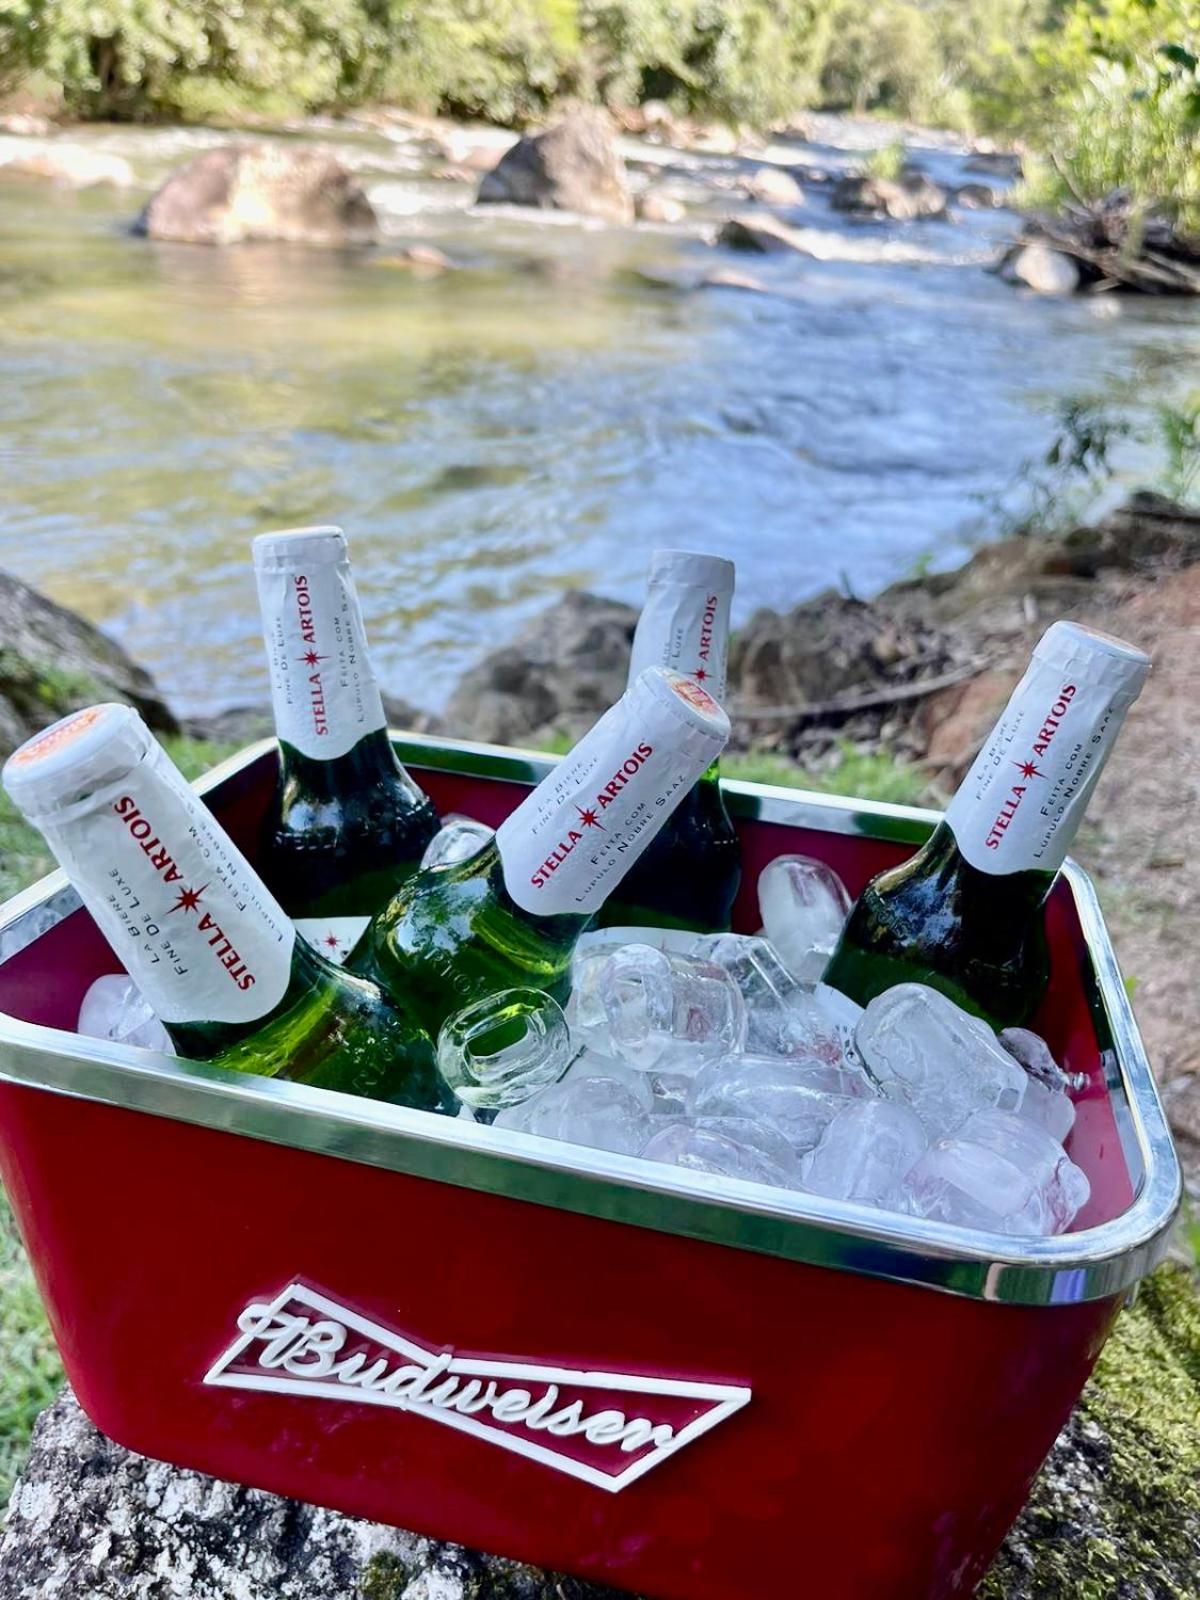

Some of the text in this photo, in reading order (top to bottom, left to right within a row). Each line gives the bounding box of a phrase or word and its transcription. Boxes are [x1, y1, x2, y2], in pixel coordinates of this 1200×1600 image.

[294, 575, 328, 736] STELLA ARTOIS
[698, 595, 718, 662] ARTOIS
[985, 683, 1076, 851] STELLA ARTOIS
[1065, 743, 1082, 770] COM
[114, 795, 184, 884] ARTOIS
[530, 742, 654, 889] STELLA ARTOIS
[624, 802, 647, 827] COM
[196, 912, 257, 993] STELLA
[237, 1303, 677, 1452] Budweiser
